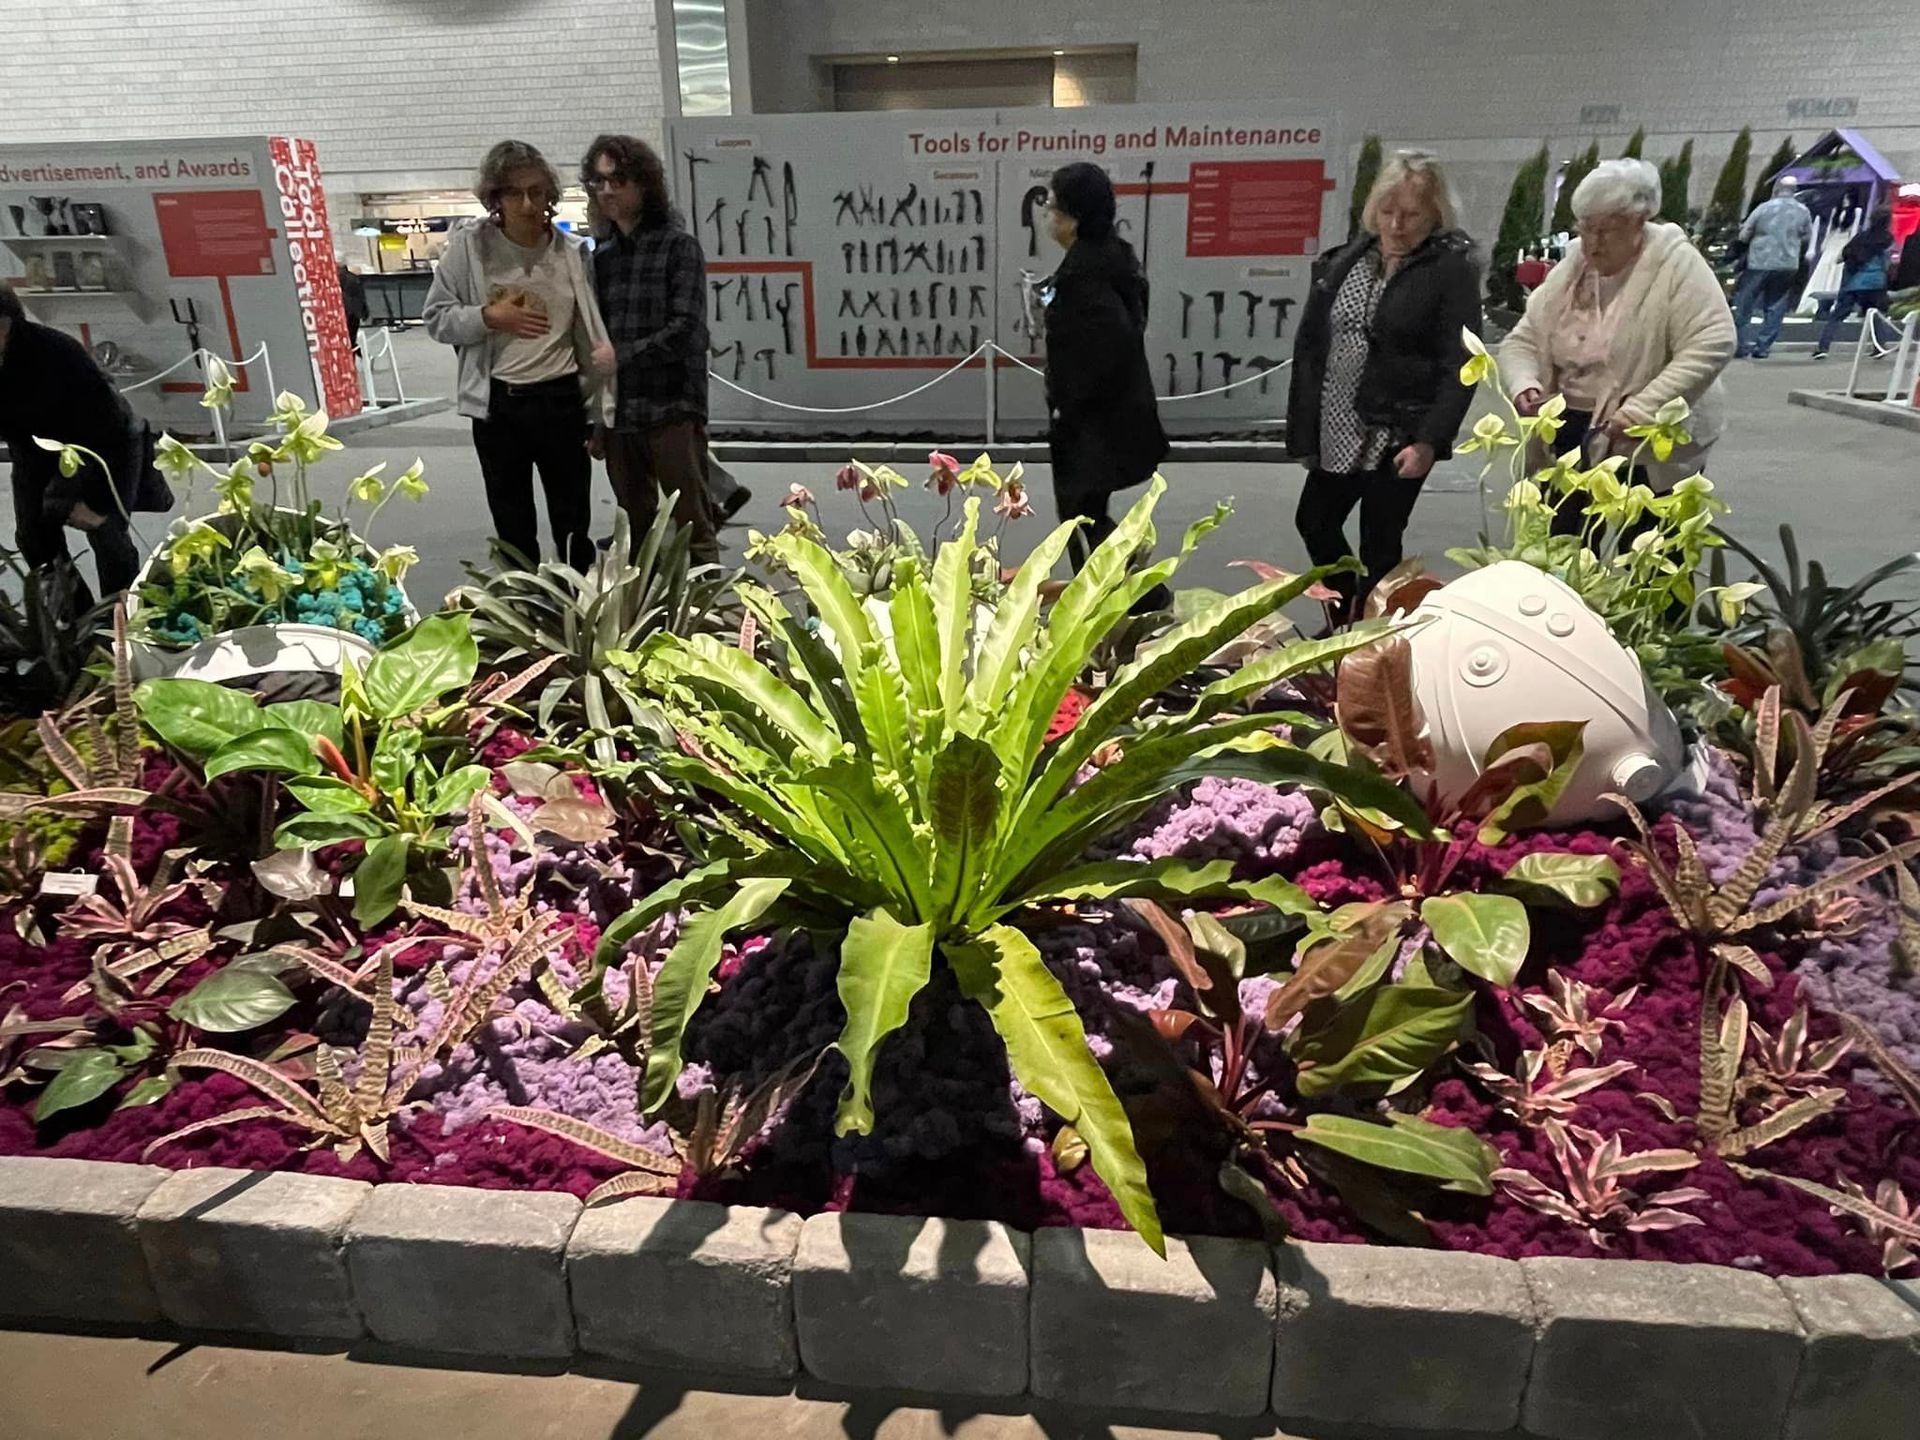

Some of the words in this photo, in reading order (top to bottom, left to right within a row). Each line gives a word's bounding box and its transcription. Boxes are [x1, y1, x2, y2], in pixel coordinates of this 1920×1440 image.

[909, 130, 970, 154] Tools
[978, 131, 1009, 152] for
[1017, 129, 1106, 154] Pruning
[1115, 127, 1156, 148] and
[1165, 125, 1321, 147] Maintenance
[135, 159, 170, 179] and
[176, 157, 250, 178] Awards
[294, 162, 324, 239] Tool
[275, 164, 321, 352] Collection
